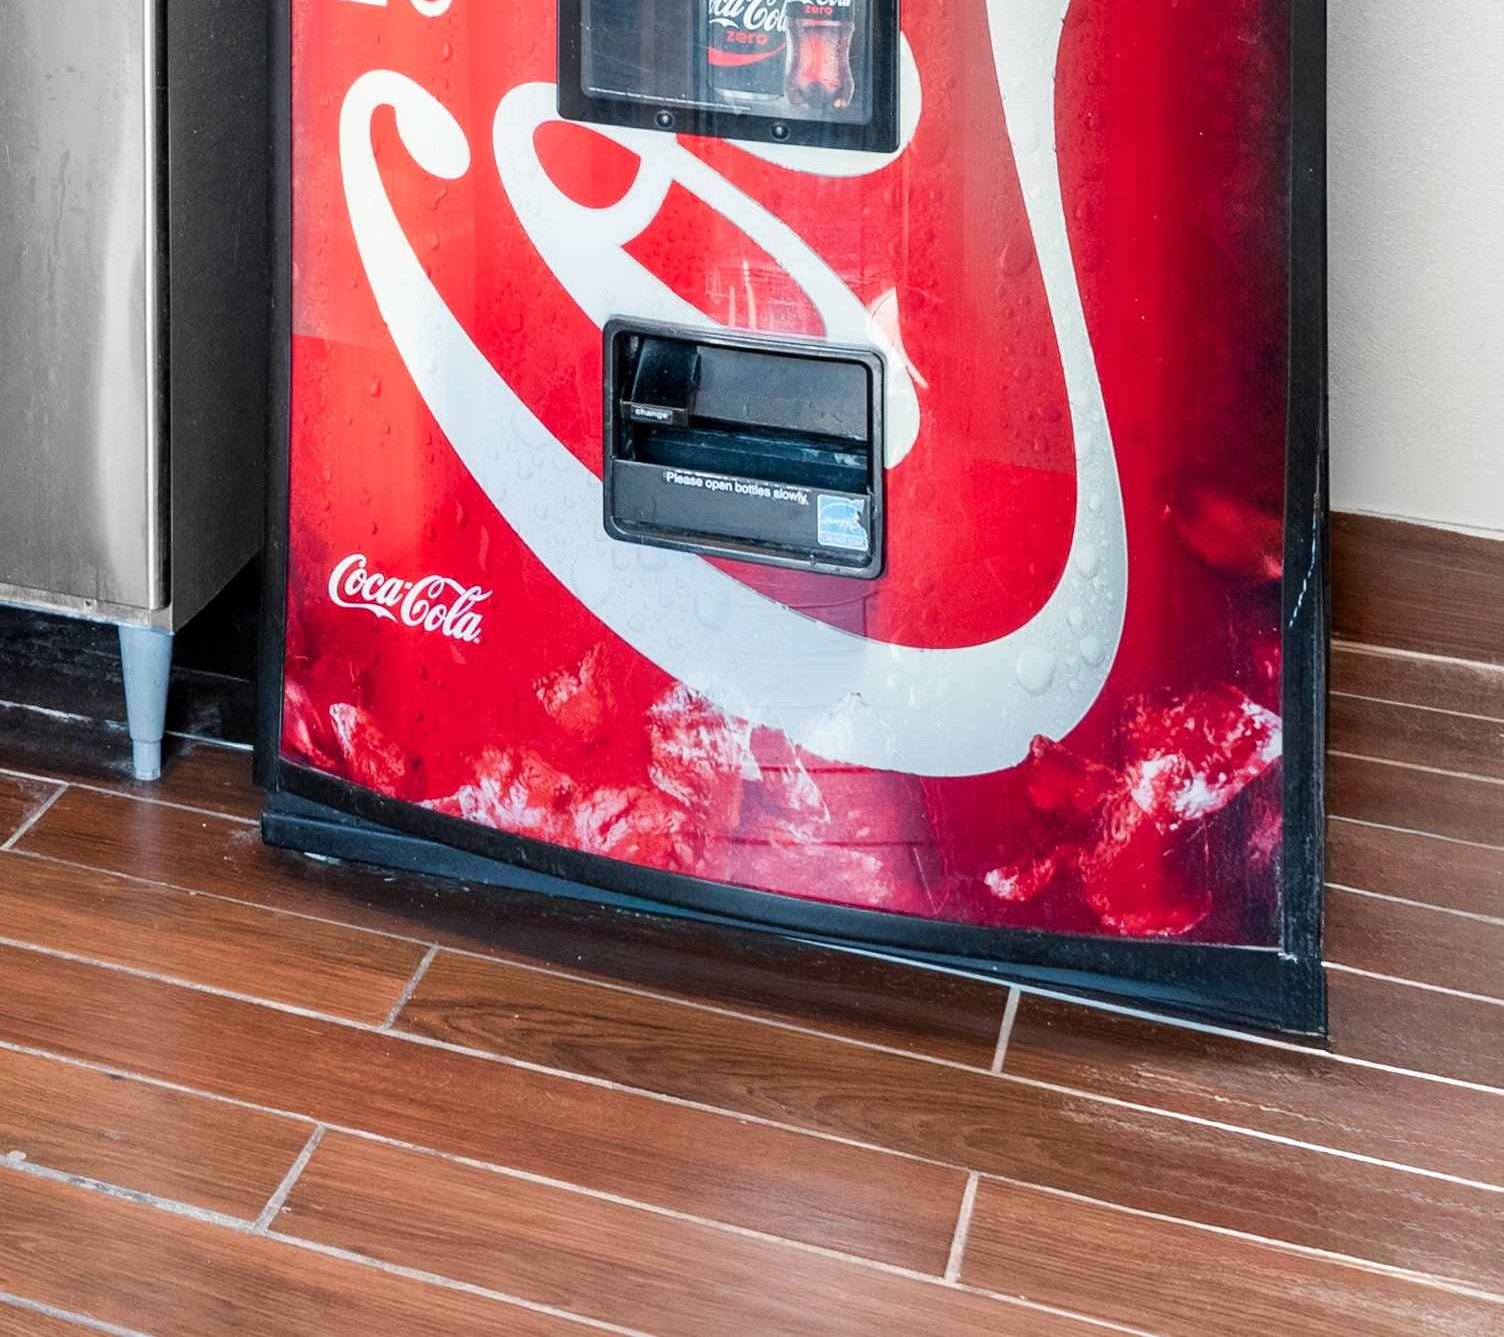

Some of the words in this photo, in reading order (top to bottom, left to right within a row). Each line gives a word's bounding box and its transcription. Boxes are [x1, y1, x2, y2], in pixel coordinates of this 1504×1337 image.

[804, 5, 833, 15] zero
[725, 30, 768, 46] zero
[635, 407, 669, 420] change
[666, 471, 703, 487] Please
[705, 479, 732, 493] open
[734, 481, 771, 497] bottles
[327, 551, 494, 646] Coca-Cola
